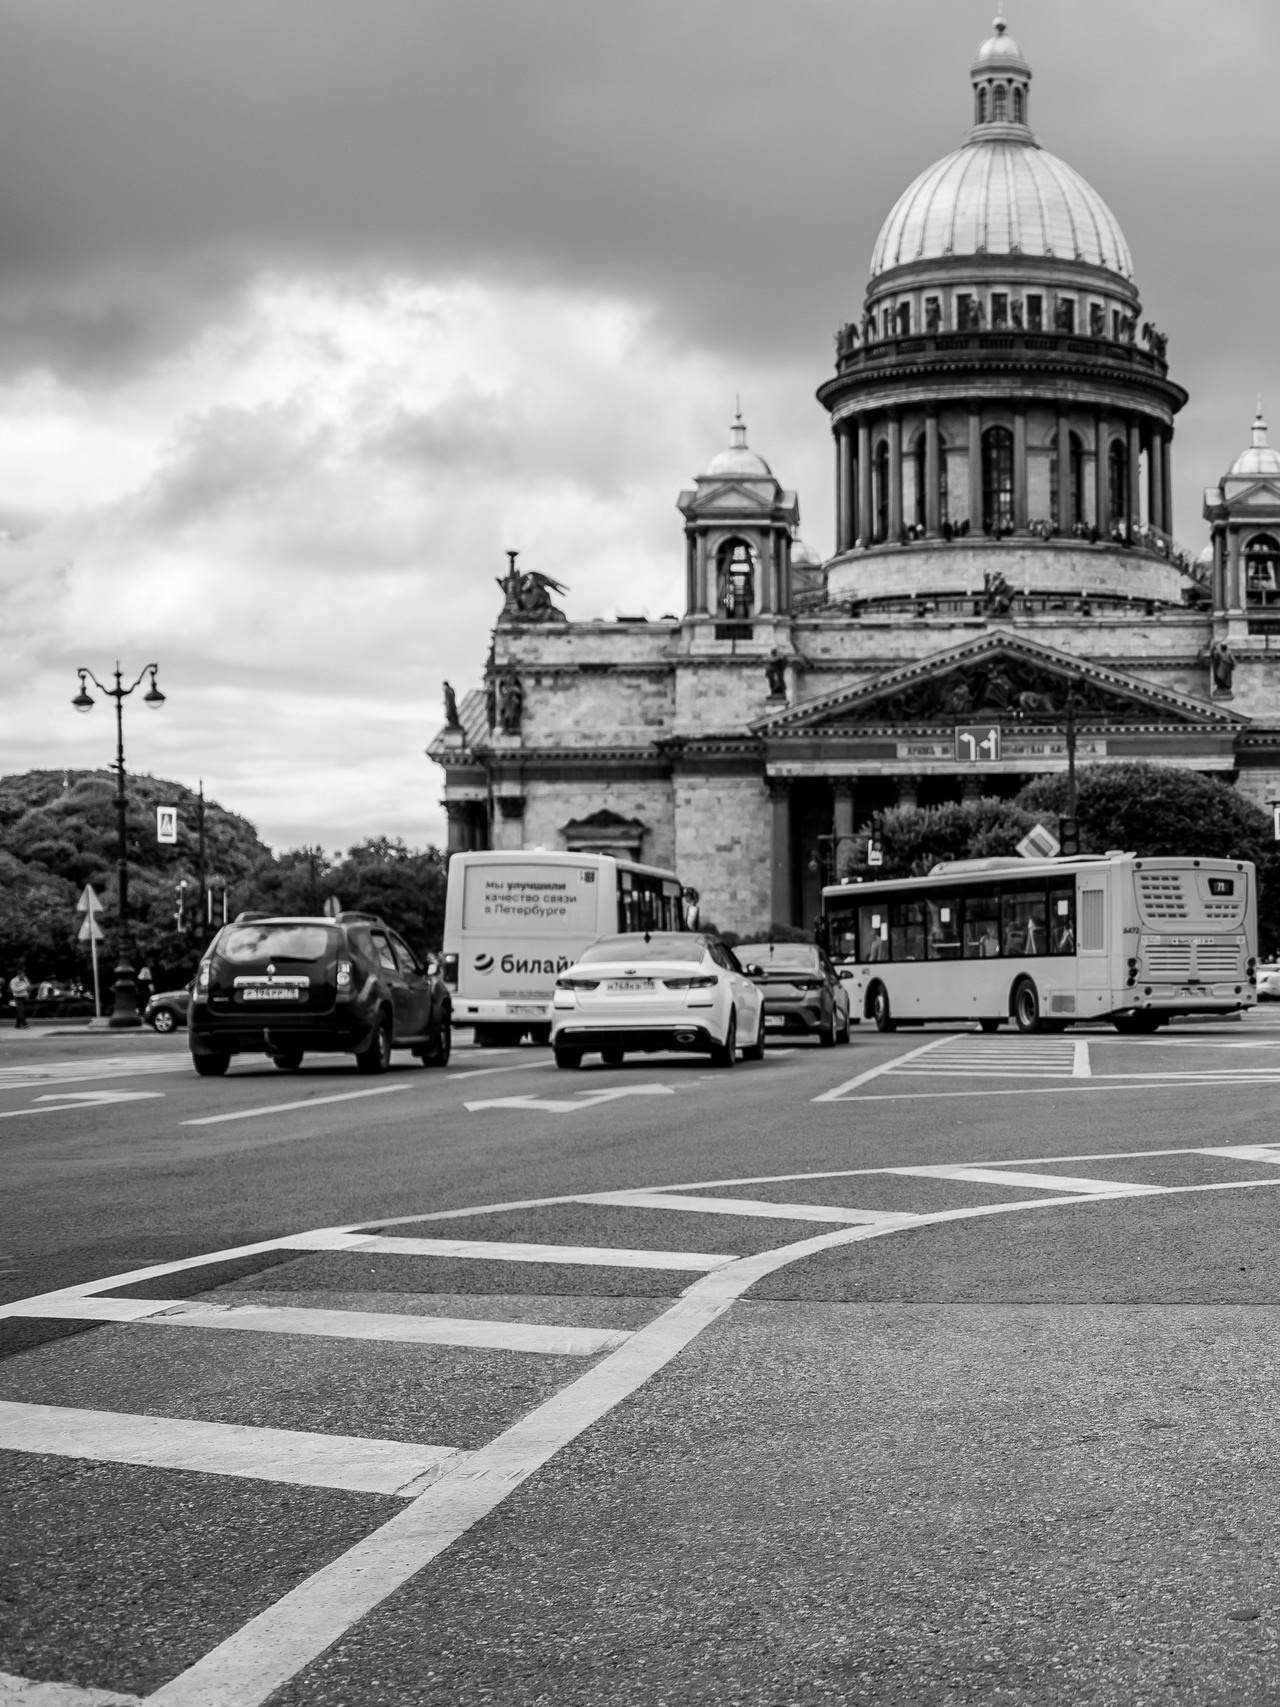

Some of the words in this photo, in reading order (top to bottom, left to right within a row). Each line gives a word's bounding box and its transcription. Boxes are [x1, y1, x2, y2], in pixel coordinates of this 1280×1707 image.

[485, 894, 539, 903] качество
[543, 894, 577, 903] связи
[495, 904, 566, 916] Петербурге
[501, 954, 575, 974] билай
